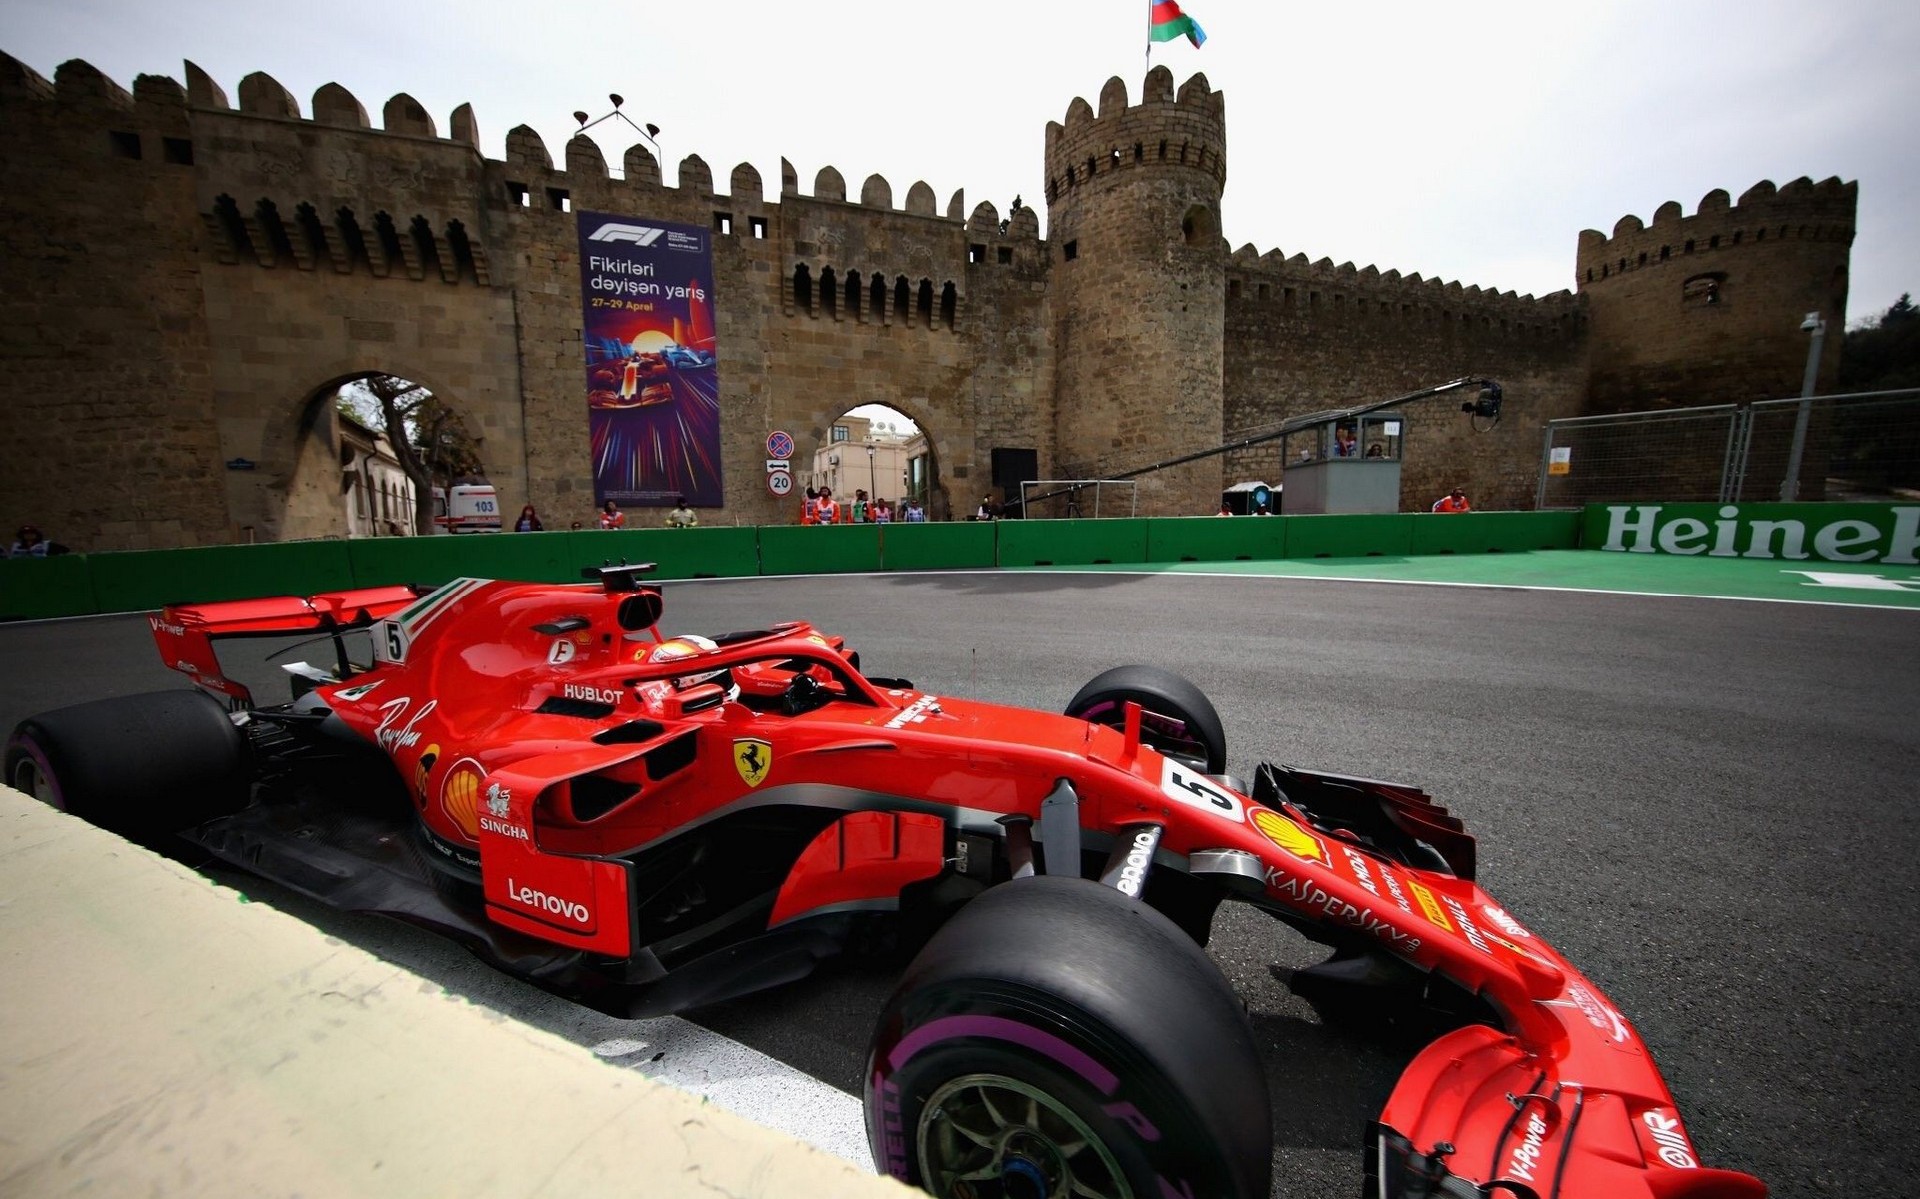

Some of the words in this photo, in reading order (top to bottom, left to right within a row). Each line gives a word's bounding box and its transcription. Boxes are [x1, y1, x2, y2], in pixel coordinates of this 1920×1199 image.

[590, 256, 654, 276] Fikirləri
[591, 275, 660, 296] dəyişən
[665, 285, 705, 303] yarış
[626, 301, 653, 312] Aprel
[774, 477, 788, 488] 20
[475, 501, 494, 512] 103
[387, 623, 402, 660] 5
[564, 683, 624, 704] HUBLOT
[1172, 772, 1234, 810] 5
[480, 817, 529, 840] SINGHA
[1116, 832, 1155, 897] enovo
[508, 878, 589, 923] Lenovo
[1265, 865, 1407, 941] KASPERSKY
[875, 1070, 909, 1181] RELLI
[1509, 1112, 1547, 1182] V-Power
